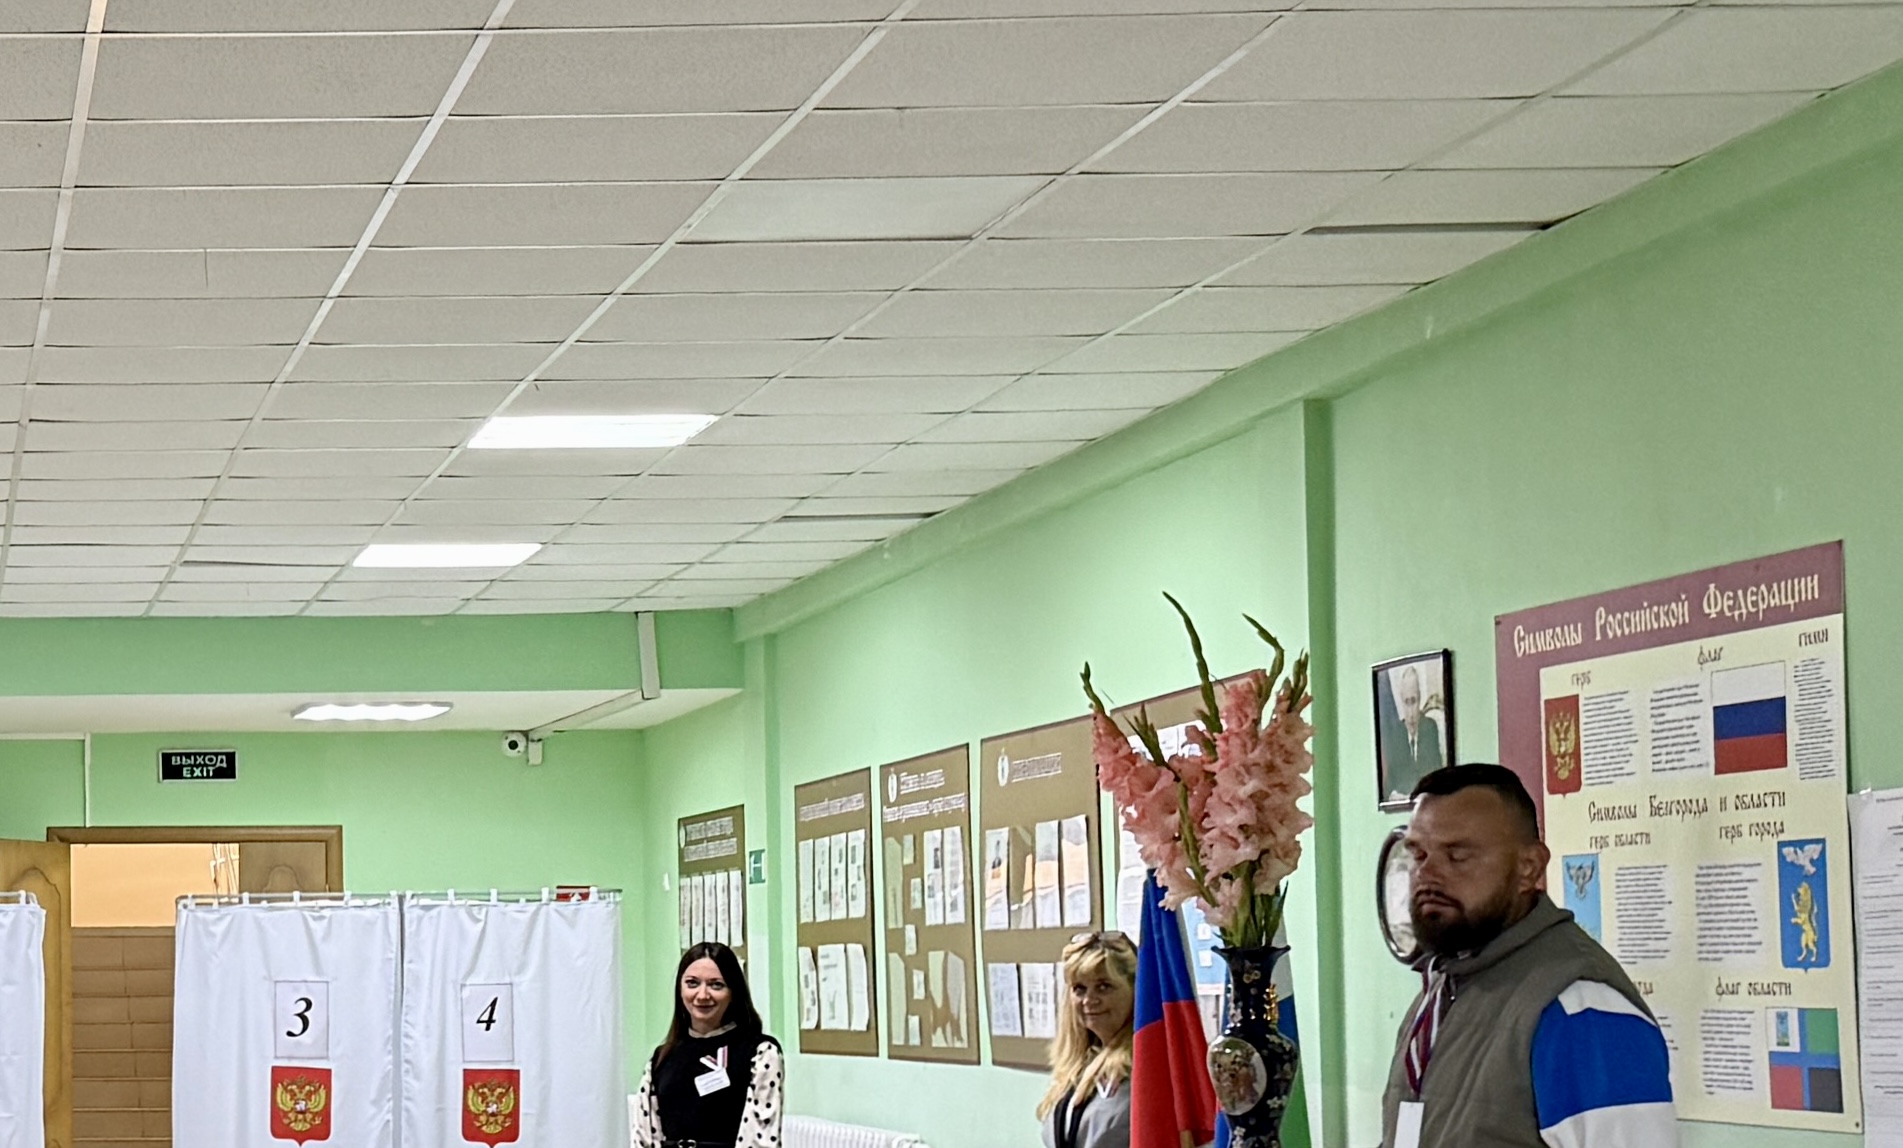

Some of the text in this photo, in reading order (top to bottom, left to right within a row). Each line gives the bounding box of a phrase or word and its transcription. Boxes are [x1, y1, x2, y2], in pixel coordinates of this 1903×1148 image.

[1513, 573, 1820, 658] Символы Российской Федерации
[171, 754, 227, 768] ВЫХОД
[183, 767, 214, 777] EXIT
[286, 997, 313, 1037] 3
[476, 996, 499, 1032] 4
